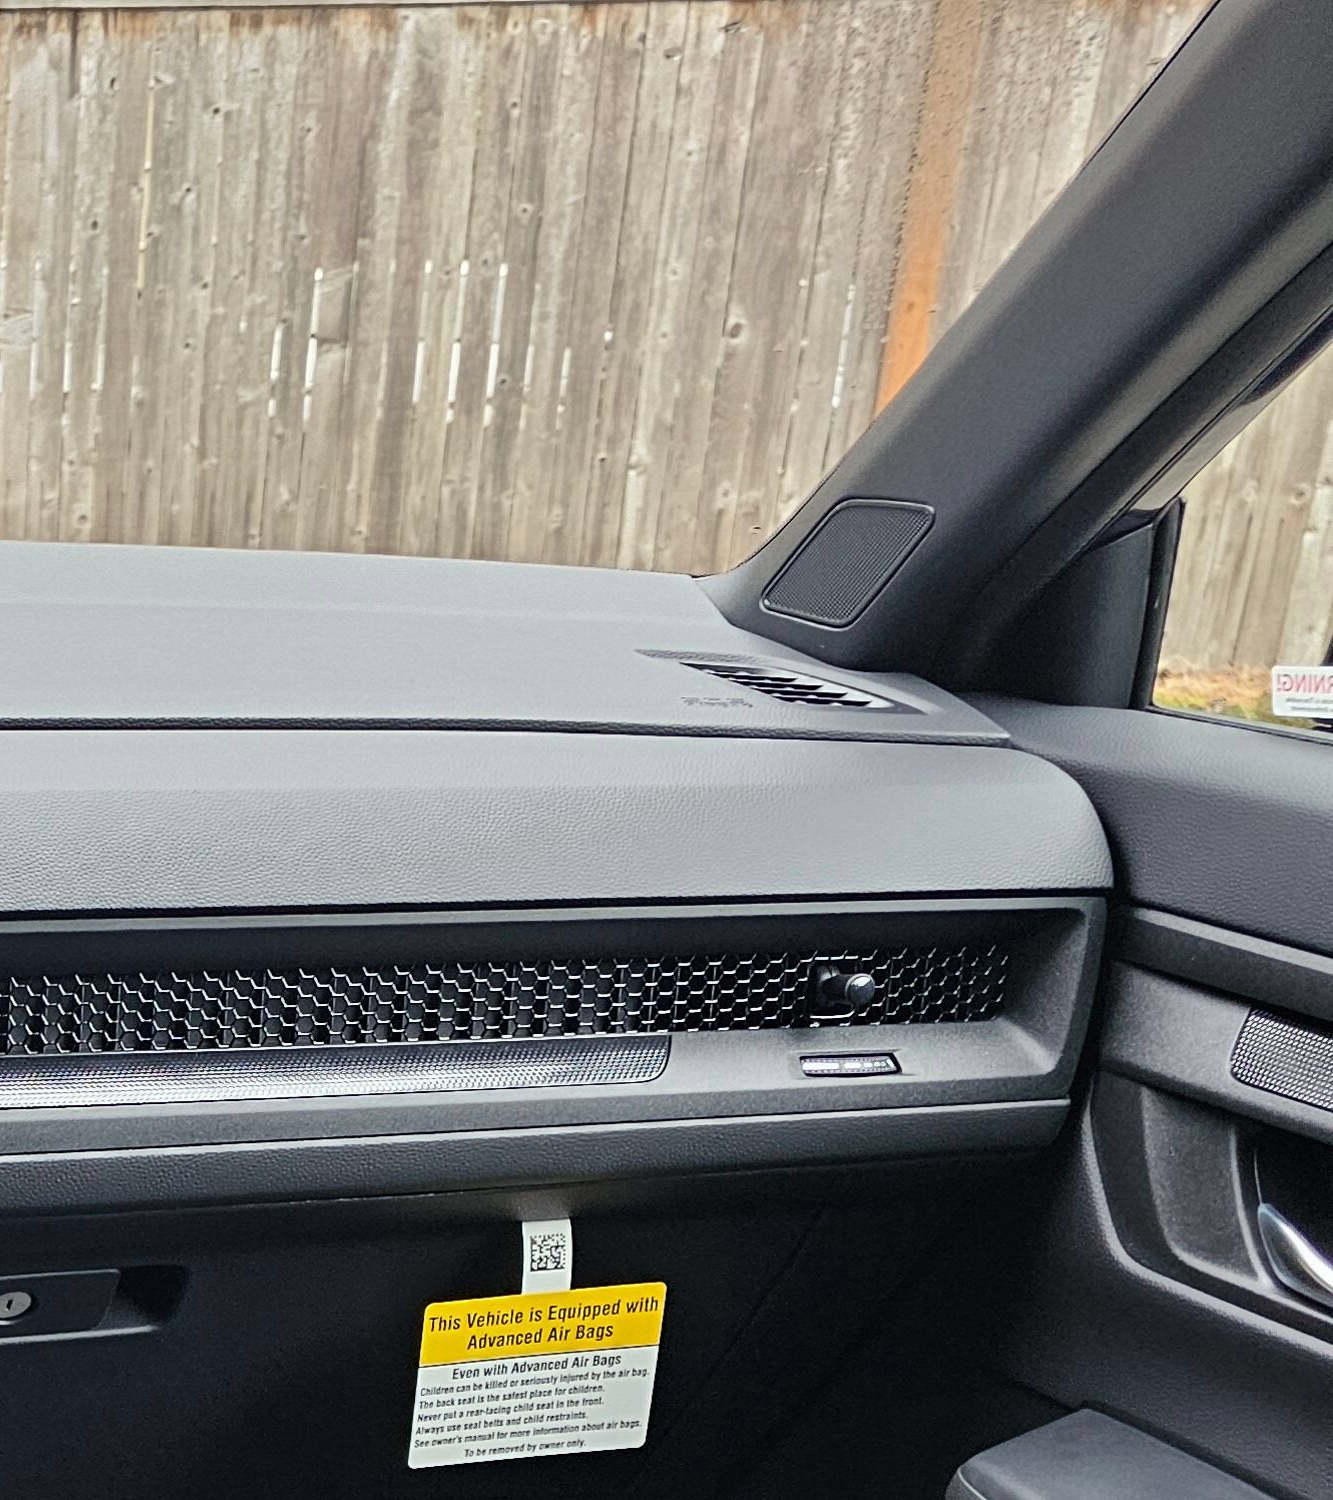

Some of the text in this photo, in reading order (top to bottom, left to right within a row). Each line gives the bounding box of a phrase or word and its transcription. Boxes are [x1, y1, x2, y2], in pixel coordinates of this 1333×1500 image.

[429, 1296, 658, 1332] This Vehicle is Equipped with
[466, 1324, 614, 1350] Advanced Air Bags
[452, 1355, 621, 1380] Even with Advanced Air Bags
[420, 1386, 454, 1397] Children
[456, 1385, 470, 1393] can
[472, 1382, 483, 1391] be
[484, 1379, 507, 1390] killed
[521, 1376, 557, 1387] seriously
[559, 1372, 589, 1384] injured
[591, 1372, 601, 1381] by
[602, 1370, 616, 1379] the
[618, 1368, 630, 1377] air
[632, 1367, 650, 1378] bag.
[417, 1413, 441, 1422] Never
[443, 1410, 457, 1420] put
[466, 1405, 511, 1418] rear-facing
[513, 1402, 534, 1412] child
[536, 1401, 554, 1411] seat
[566, 1399, 580, 1408] the
[419, 1401, 433, 1410] The
[436, 1399, 455, 1408] back
[457, 1396, 475, 1406] seat
[487, 1394, 500, 1402] the
[502, 1390, 527, 1401] safest
[529, 1388, 552, 1399] place
[554, 1386, 566, 1395] for
[414, 1440, 429, 1448] See
[431, 1435, 462, 1446] owner's
[464, 1432, 494, 1443] manual
[496, 1430, 508, 1439] for
[509, 1429, 530, 1438] more
[532, 1424, 580, 1436] information
[581, 1422, 605, 1432] about
[606, 1421, 618, 1430] air
[415, 1426, 444, 1436] Always
[447, 1424, 461, 1432] use
[463, 1421, 481, 1431] seat
[483, 1418, 503, 1428] belts
[505, 1416, 521, 1426] and
[523, 1414, 544, 1424] child
[464, 1449, 474, 1457] To
[476, 1447, 485, 1456] be
[488, 1444, 525, 1455] removed
[527, 1443, 536, 1452] by
[539, 1441, 565, 1450] owner
